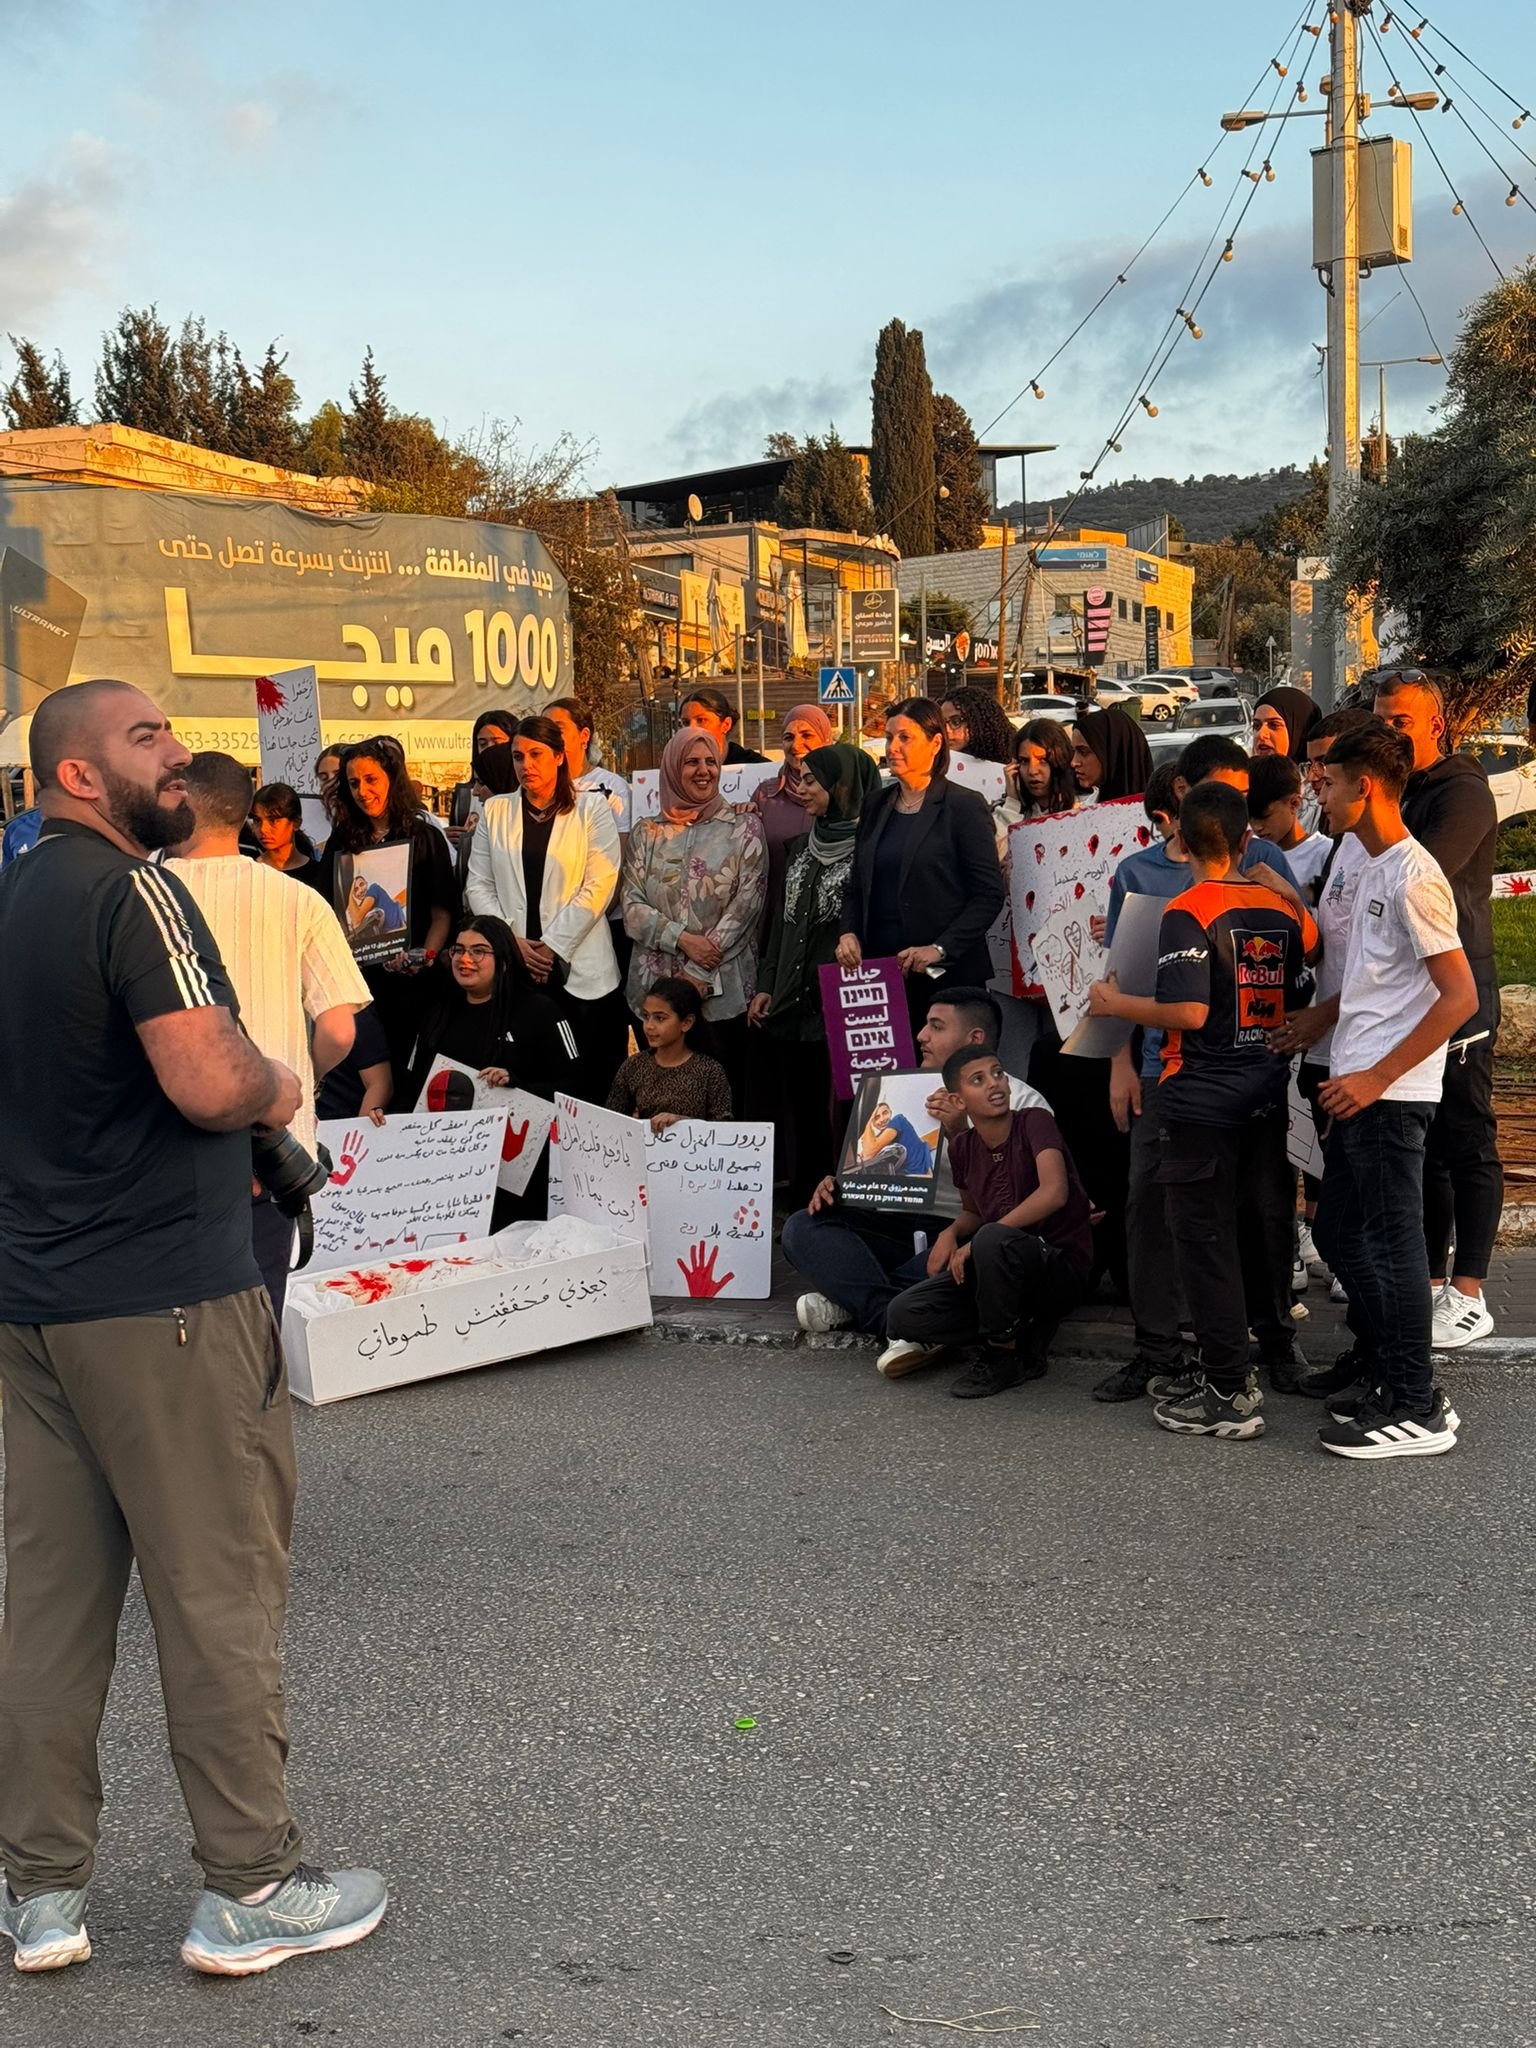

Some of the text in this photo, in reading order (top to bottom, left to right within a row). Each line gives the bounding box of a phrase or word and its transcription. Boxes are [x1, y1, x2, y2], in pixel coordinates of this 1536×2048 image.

[158, 534, 214, 560] حتى
[218, 535, 265, 568] تصل
[270, 541, 335, 578] بسرعة
[338, 547, 393, 581] انترنت
[425, 547, 500, 583] المنطقة
[502, 559, 531, 592] في
[532, 568, 554, 599] جديد
[12, 604, 71, 638] ULTRANET
[464, 609, 558, 690] 1000
[843, 986, 885, 1004] חיינו
[844, 1005, 889, 1026] ليست
[850, 1029, 890, 1048] אינם
[850, 1052, 898, 1071] رخيصة
[717, 1133, 767, 1152] يدور
[683, 1157, 725, 1173] الناس
[726, 1160, 762, 1174] جميع
